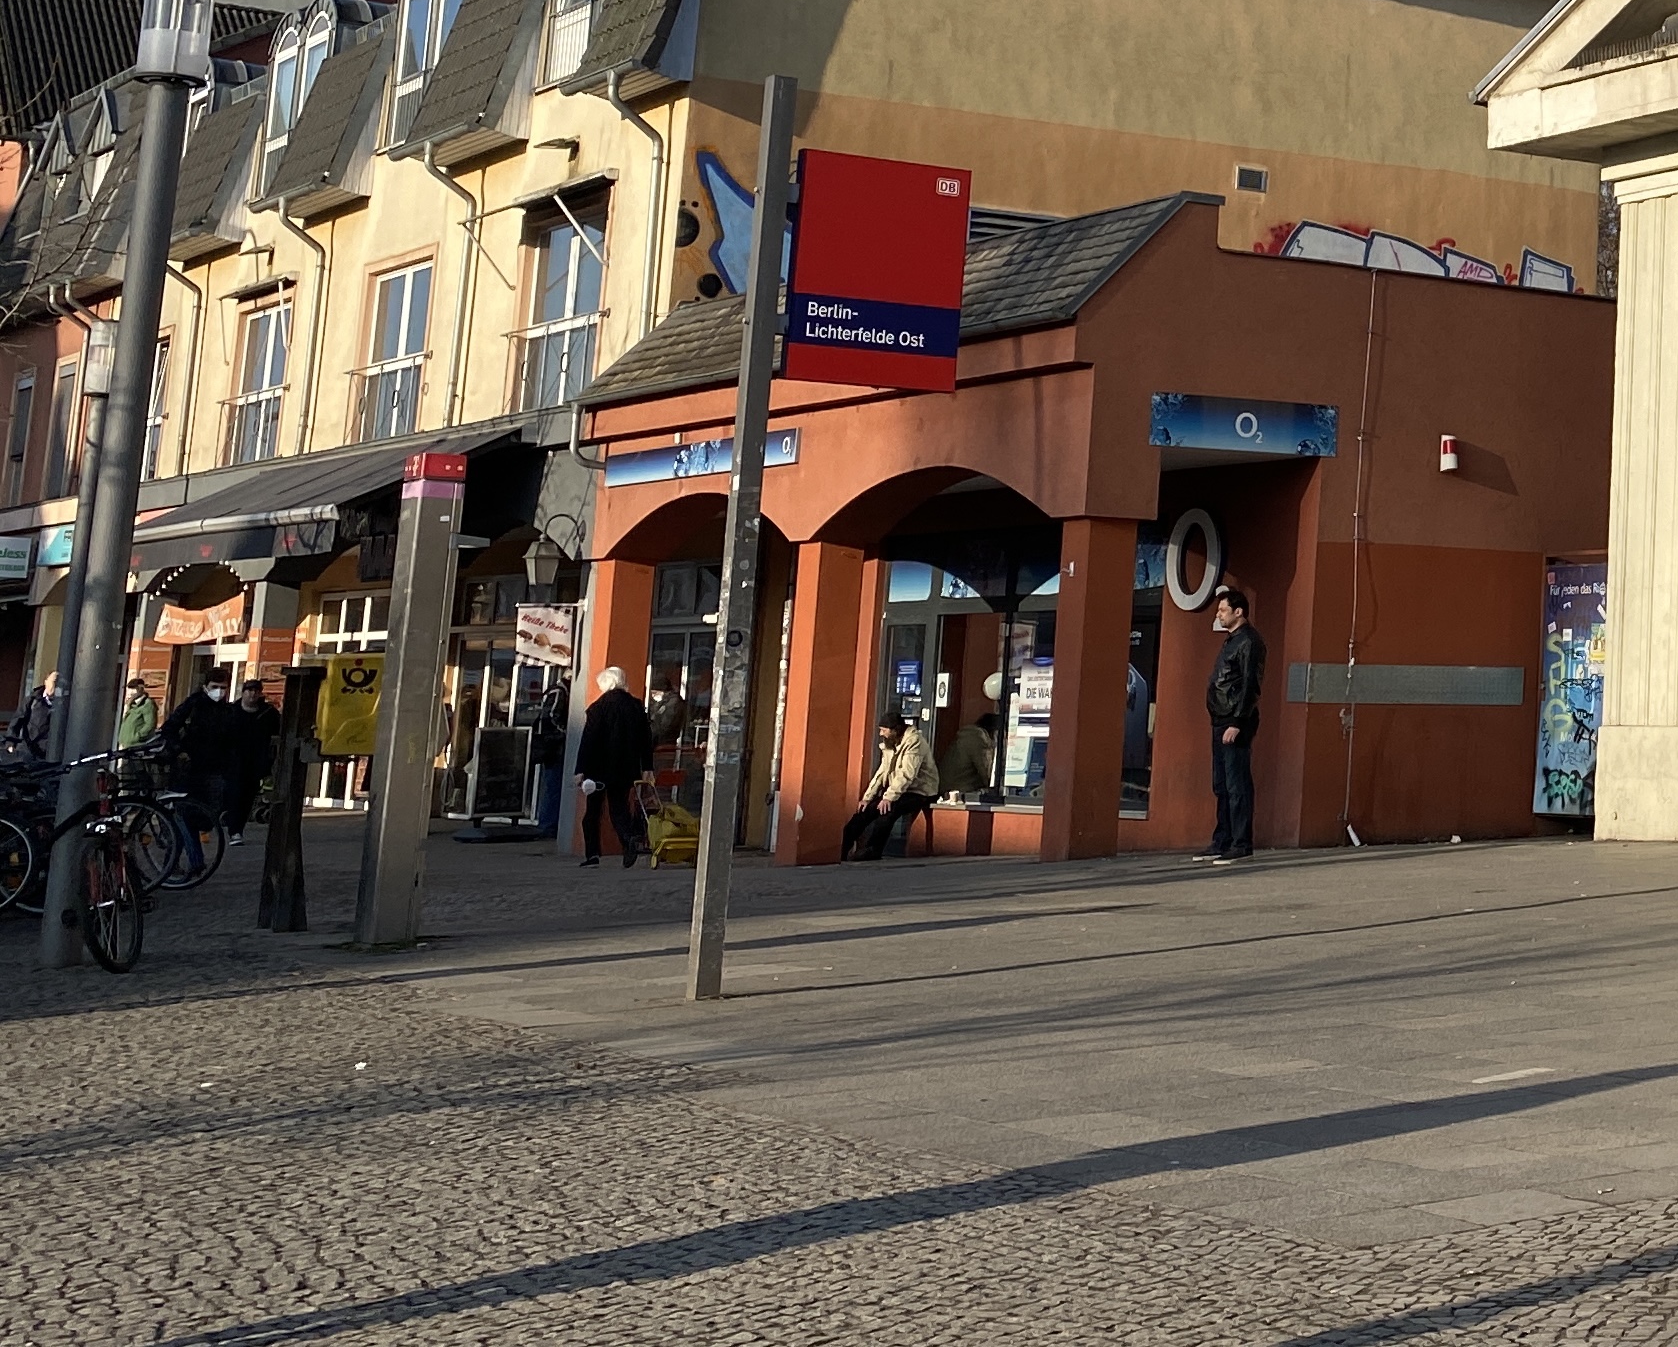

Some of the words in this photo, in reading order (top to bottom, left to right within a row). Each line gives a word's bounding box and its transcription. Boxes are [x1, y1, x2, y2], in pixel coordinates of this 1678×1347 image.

[807, 301, 859, 320] Berlin-
[805, 322, 895, 345] Lichterfelde
[899, 331, 925, 348] Ost
[1235, 412, 1263, 444] O2
